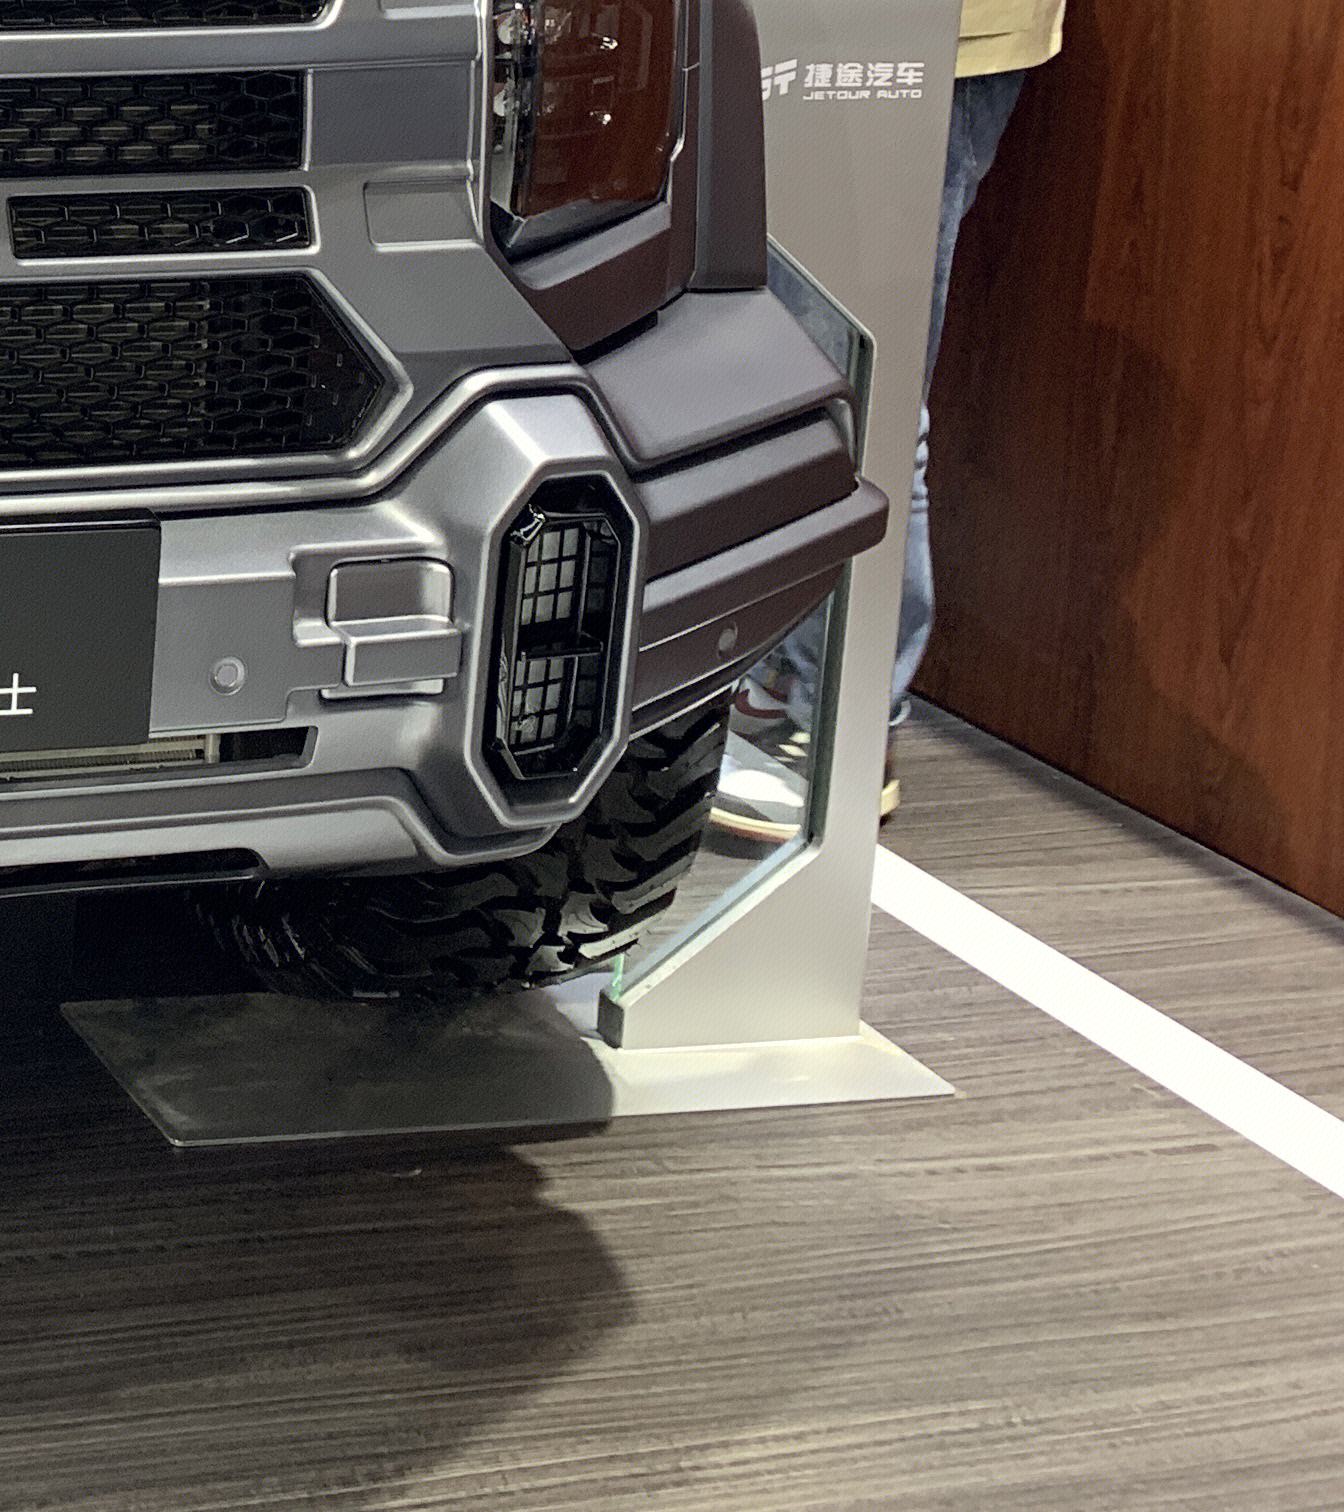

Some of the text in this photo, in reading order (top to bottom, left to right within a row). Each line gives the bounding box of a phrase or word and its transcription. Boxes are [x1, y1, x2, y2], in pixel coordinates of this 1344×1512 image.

[803, 62, 925, 88] 捷途汽车
[803, 88, 923, 101] JETOUR AUTO
